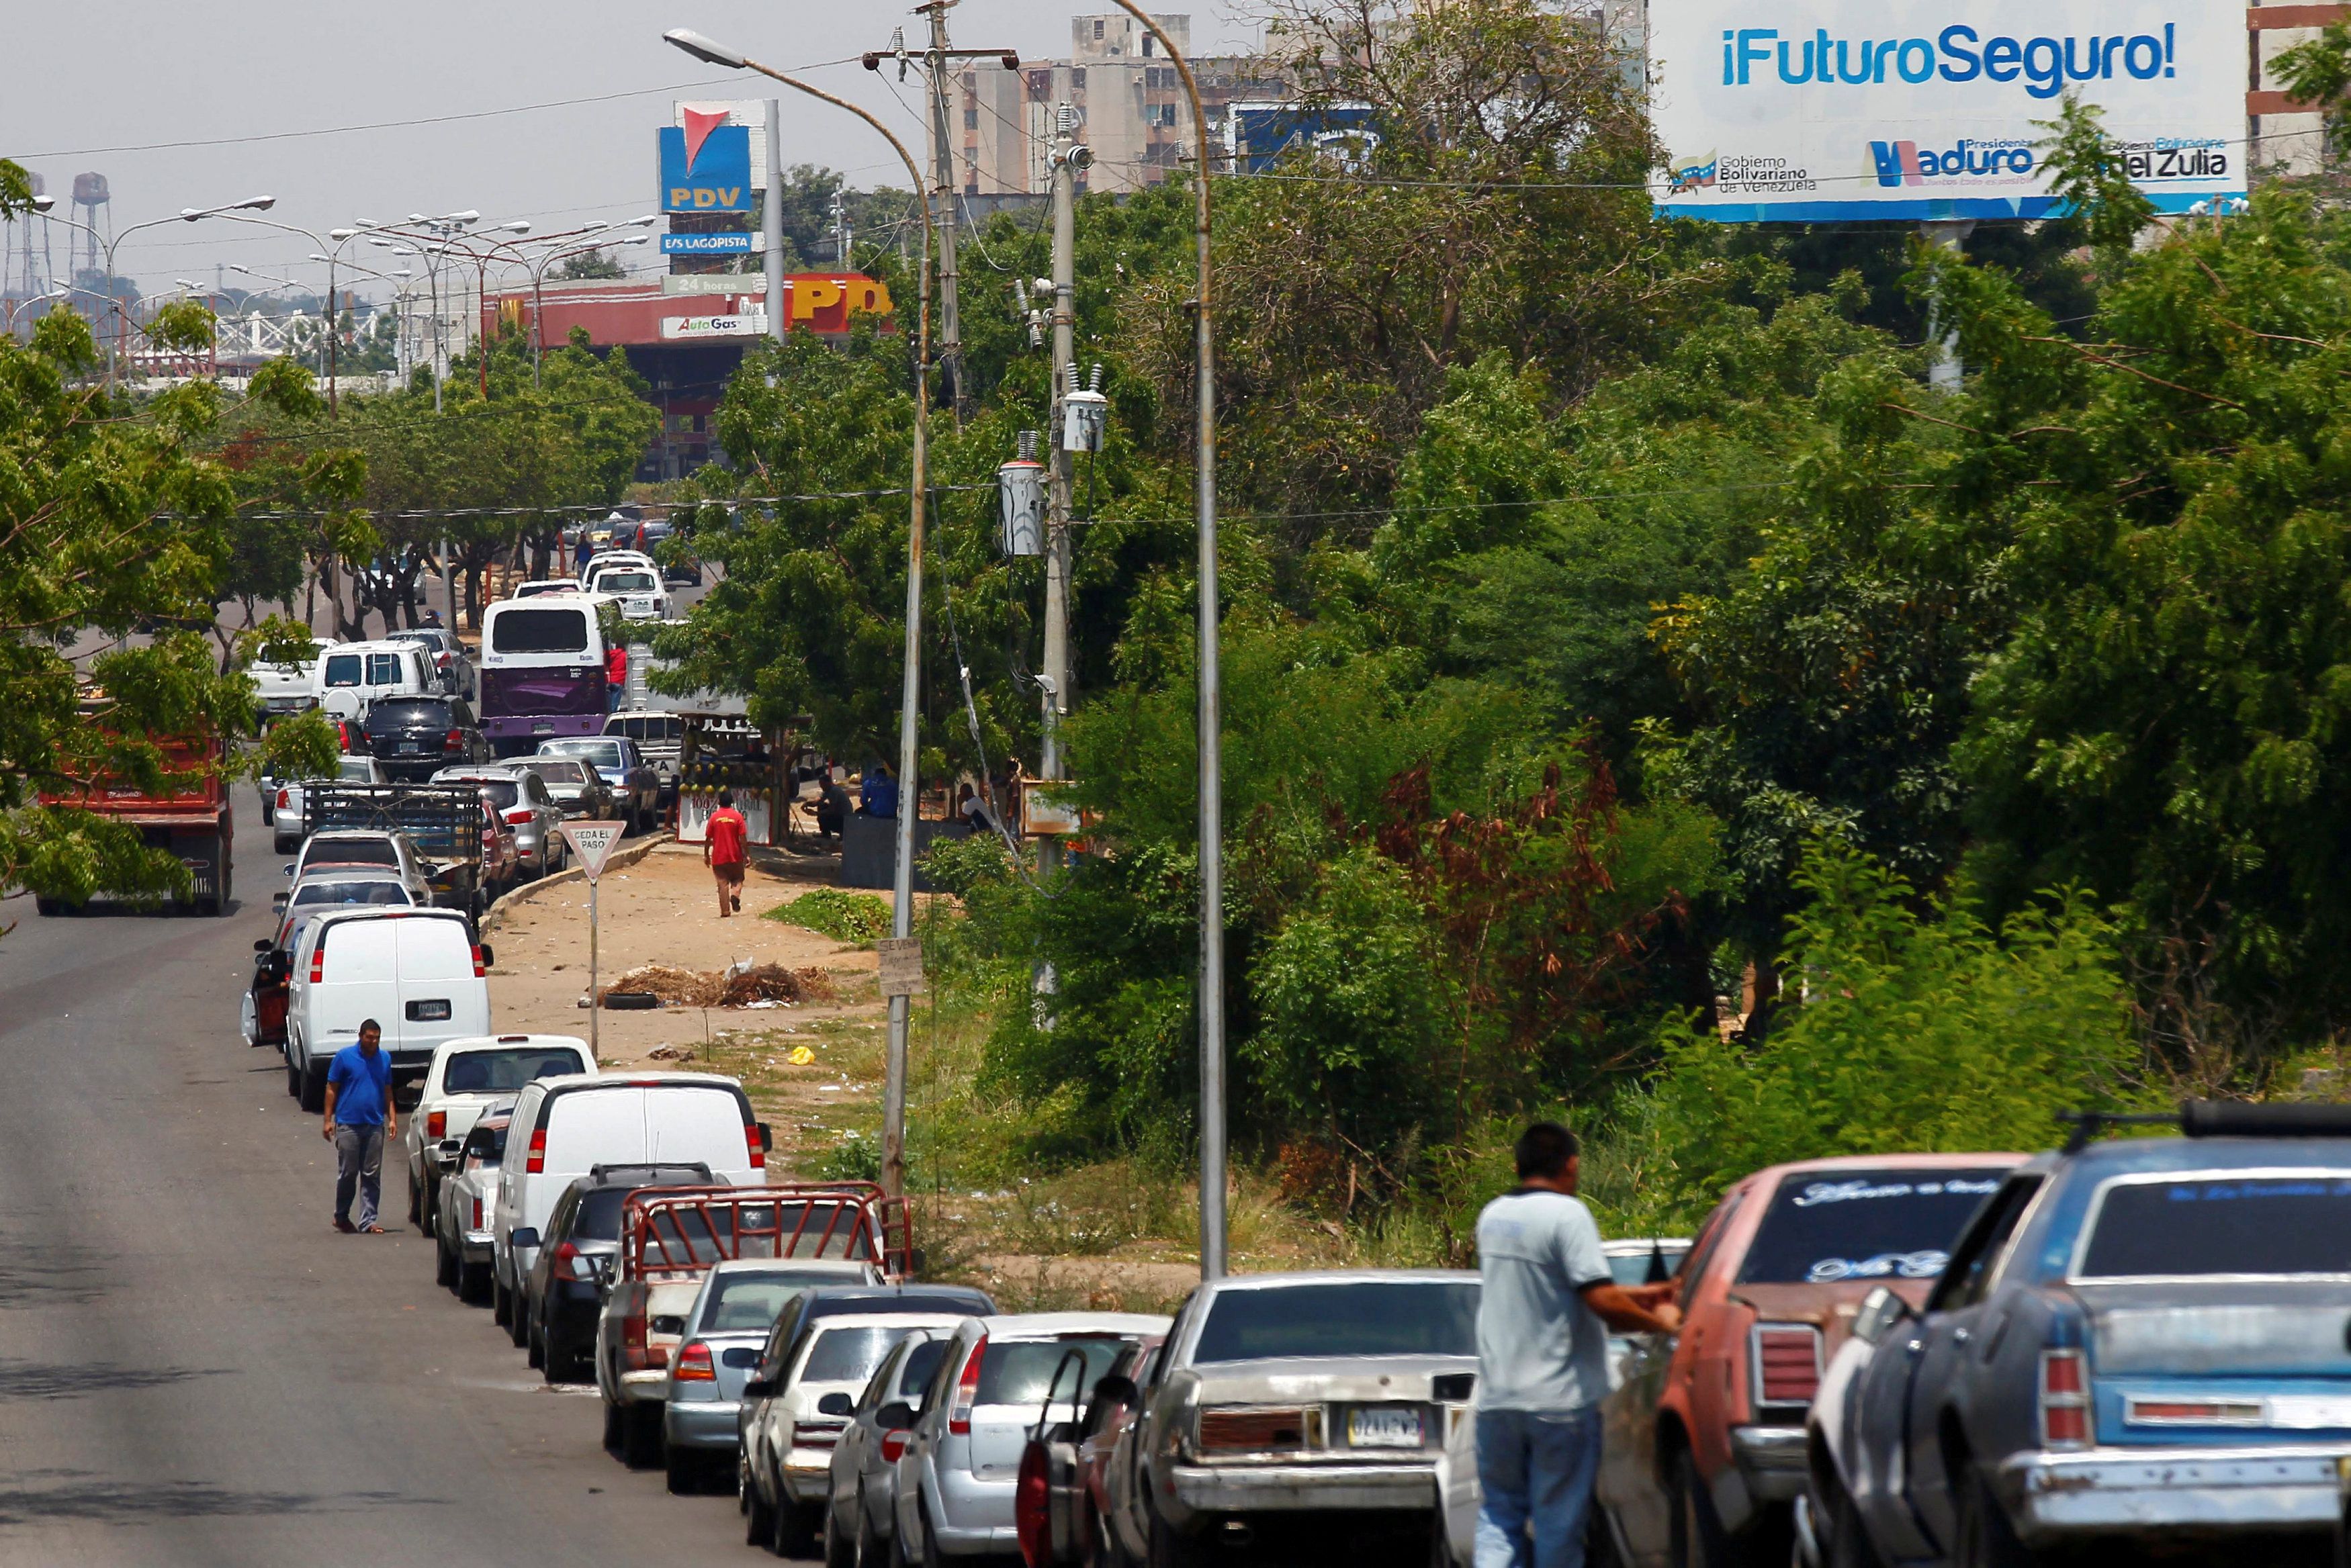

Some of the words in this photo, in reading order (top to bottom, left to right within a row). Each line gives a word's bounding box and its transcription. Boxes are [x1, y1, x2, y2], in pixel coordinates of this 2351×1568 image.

[2155, 137, 2225, 150] Bolivariano
[1720, 155, 1787, 169] Gobierno
[1859, 139, 2034, 187] Maduro
[2157, 148, 2227, 177] Zulia
[1720, 168, 1807, 181] Bolivariano
[1720, 181, 1737, 194] de
[1744, 179, 1817, 194] Venezuela
[670, 187, 740, 207] PDV
[665, 238, 683, 249] E/S
[685, 236, 748, 249] LAGOPISTA
[678, 279, 699, 291] 24
[703, 281, 737, 291] horas
[574, 831, 597, 839] CEDA
[599, 830, 610, 839] EL
[582, 841, 605, 849] PASO
